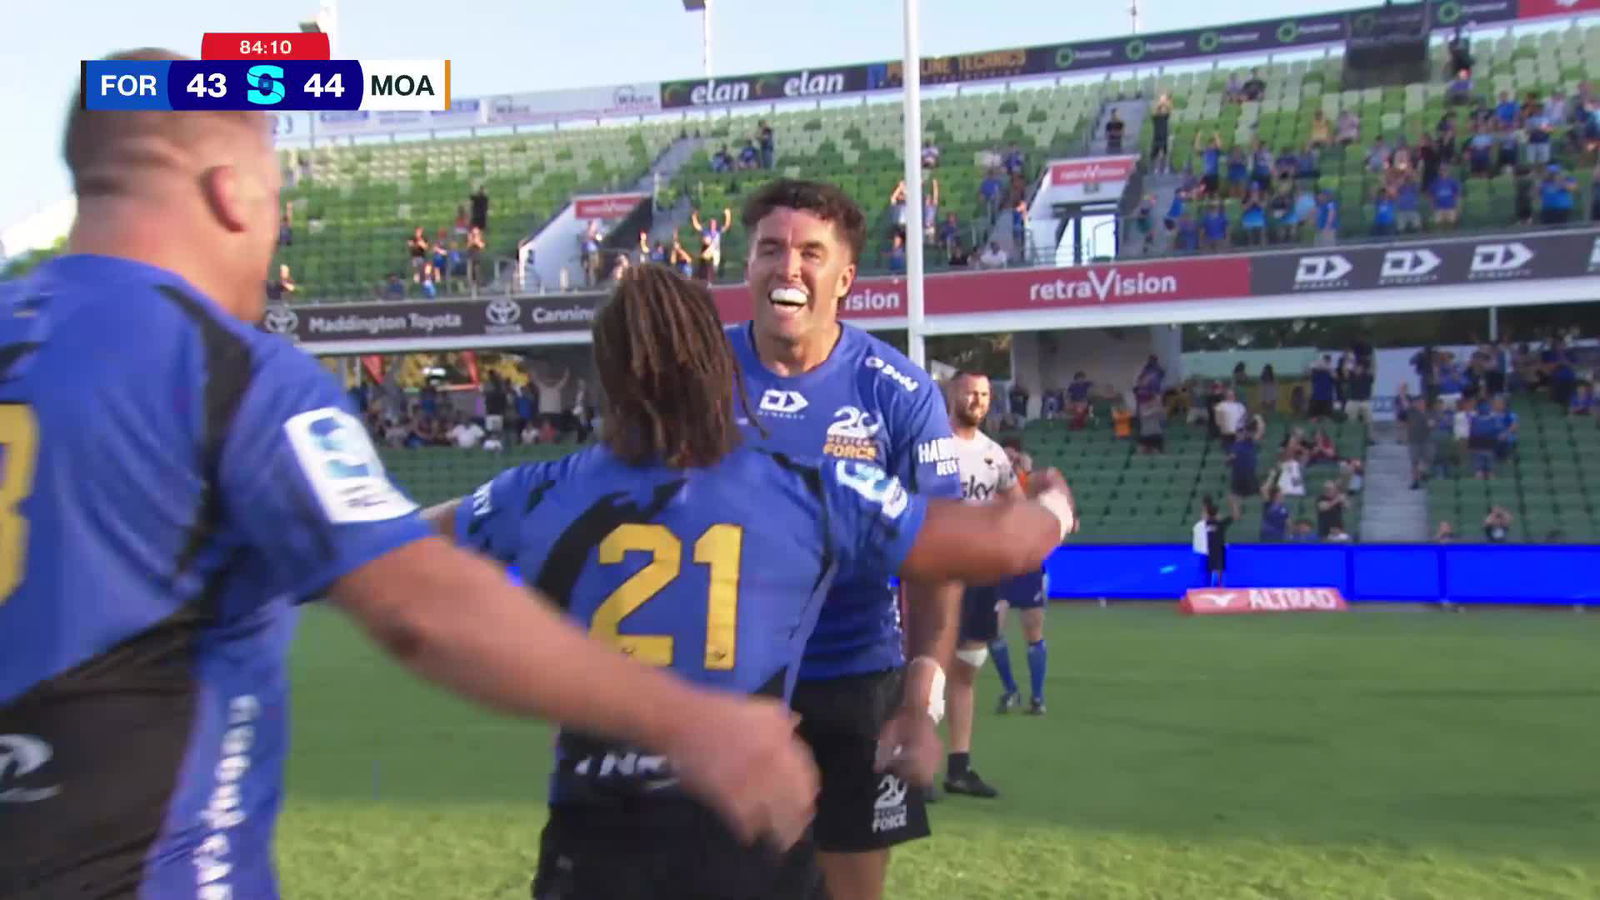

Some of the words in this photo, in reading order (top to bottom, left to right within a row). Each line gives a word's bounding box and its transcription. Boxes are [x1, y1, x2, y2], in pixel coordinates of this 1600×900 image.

[690, 79, 750, 105] elan
[784, 70, 844, 97] elan
[1030, 269, 1177, 301] retraVision
[309, 315, 407, 335] Maddington
[408, 312, 462, 334] Toyota
[589, 522, 744, 671] 21
[1249, 588, 1337, 610] ALTRAD
